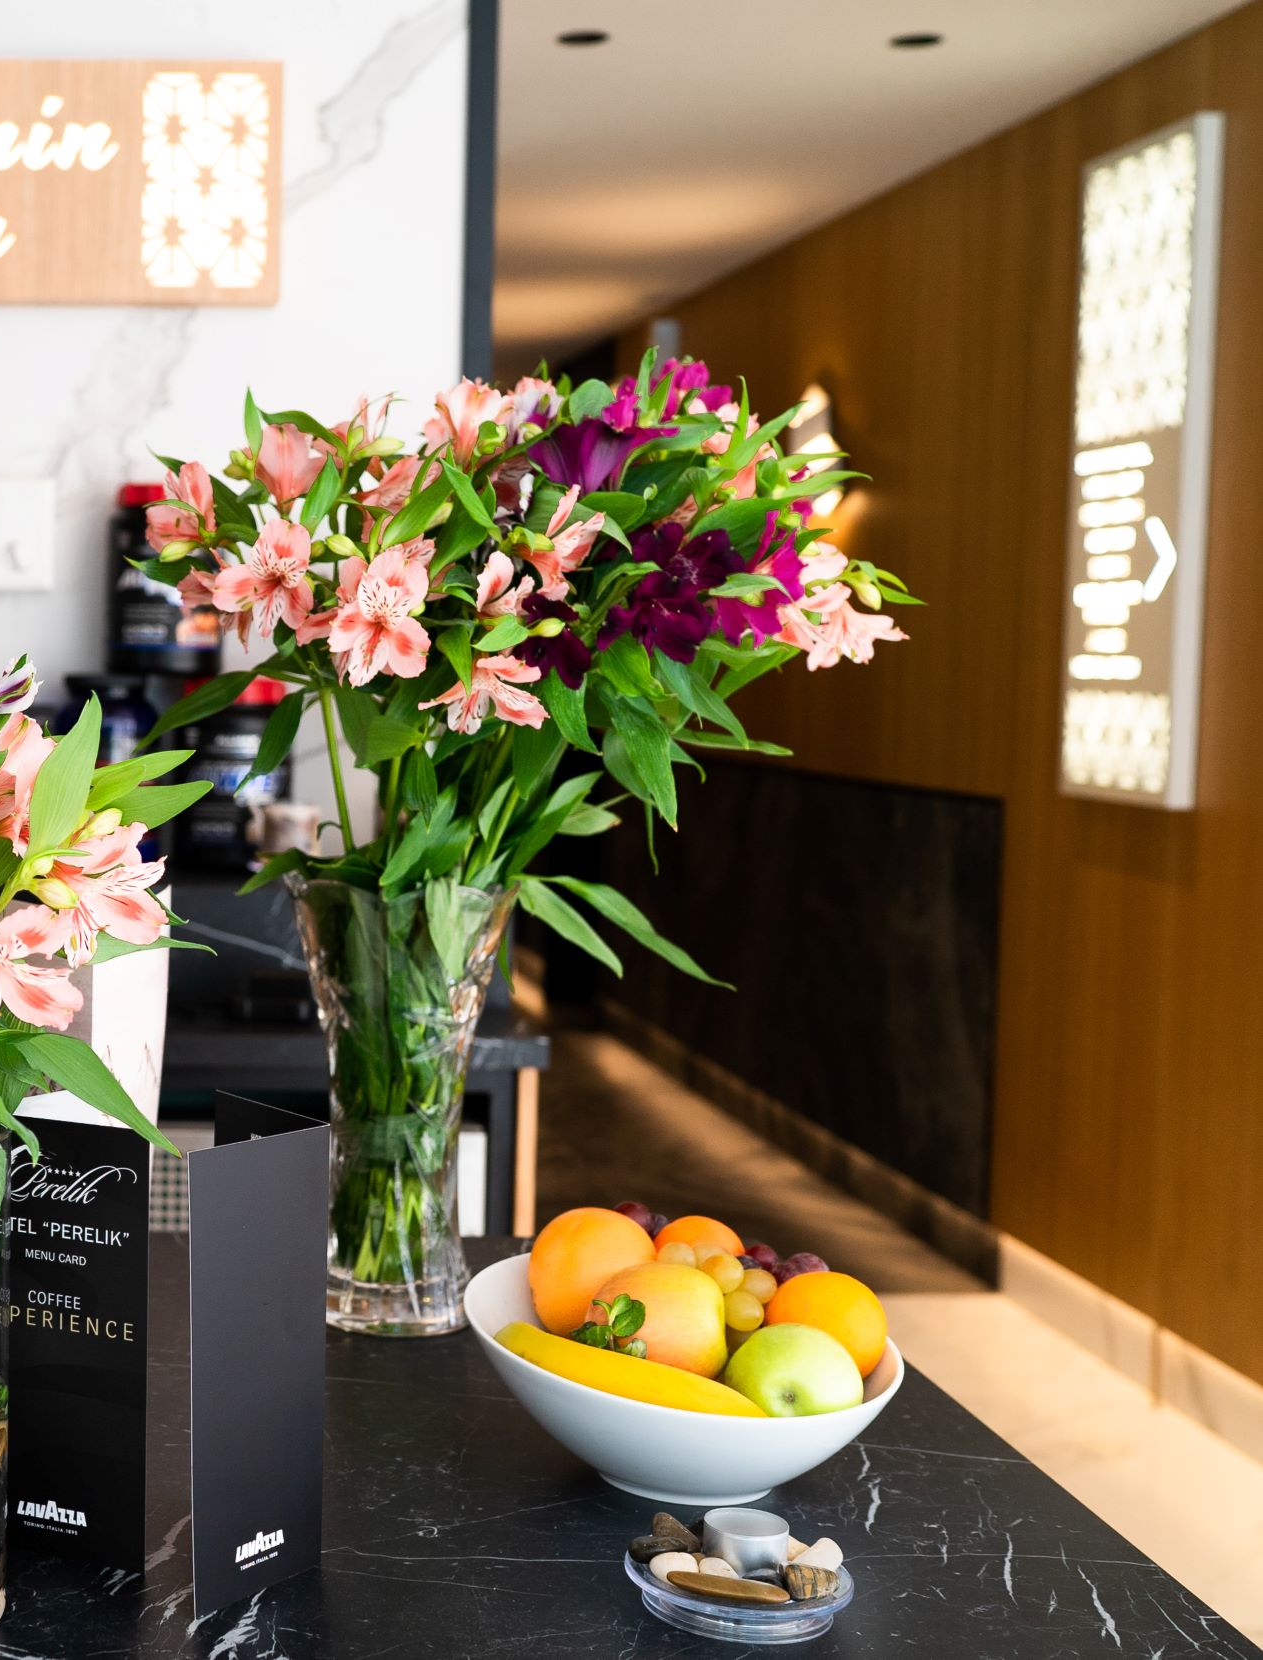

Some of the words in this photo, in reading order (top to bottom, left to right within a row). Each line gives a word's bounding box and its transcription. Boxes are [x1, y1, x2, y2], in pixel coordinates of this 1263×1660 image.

[10, 1162, 138, 1205] Perelik
[25, 1248, 56, 1262] MENU
[58, 1253, 87, 1266] CARD
[27, 1289, 82, 1311] COFFEE
